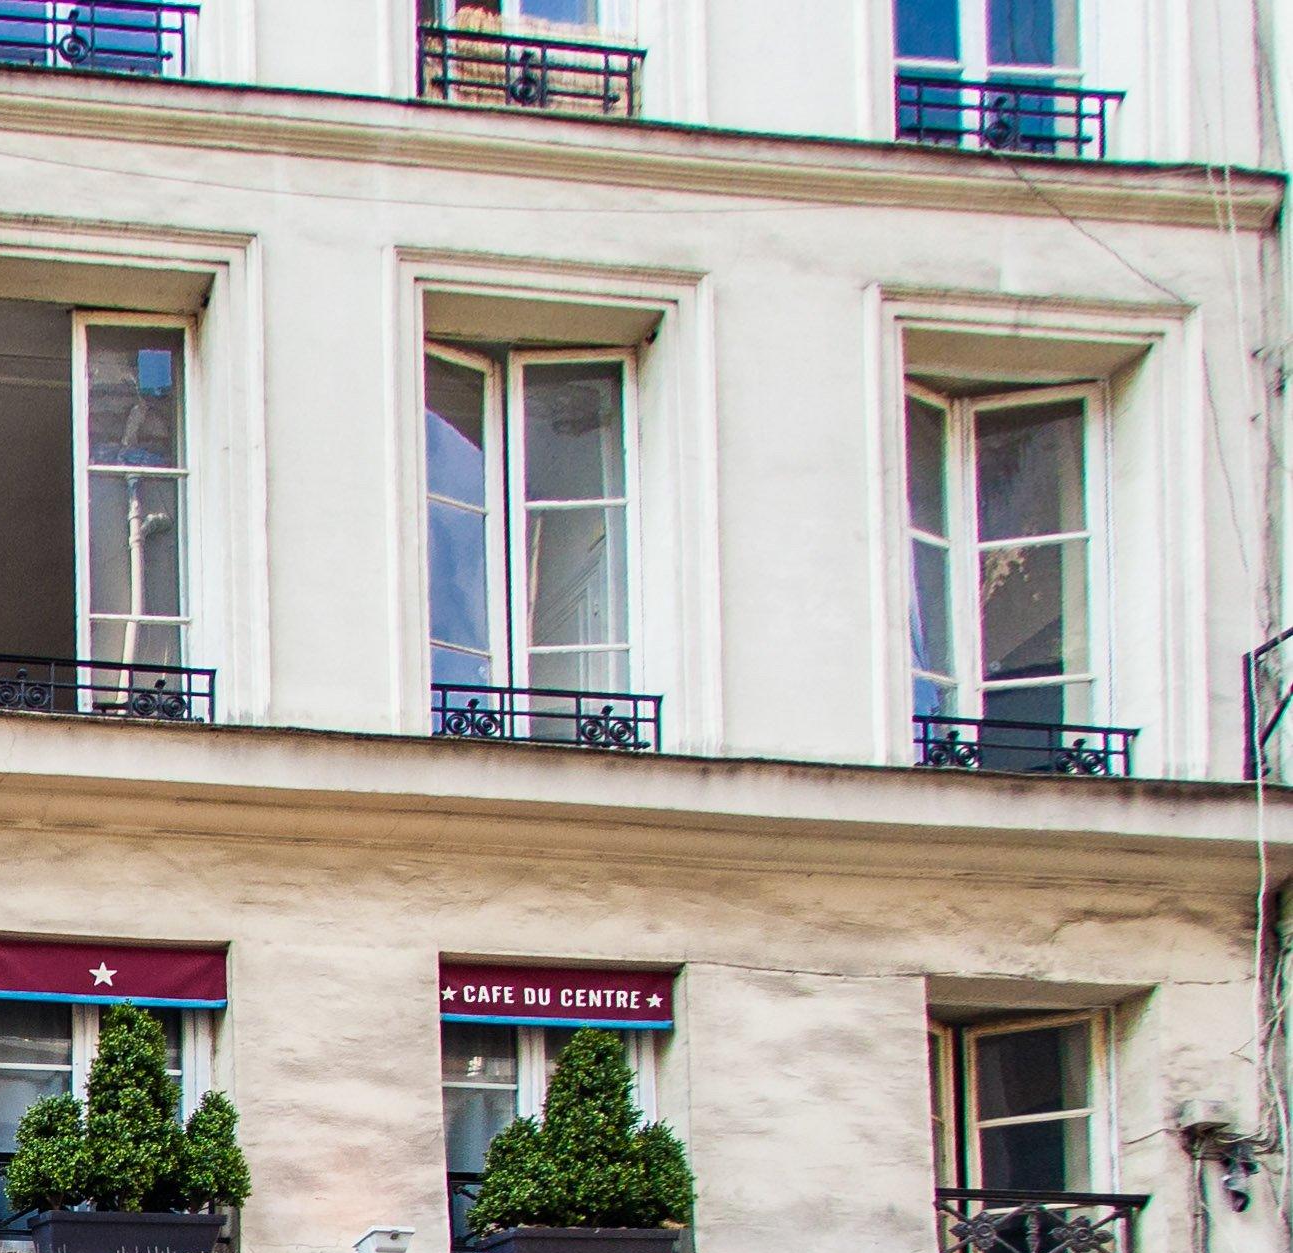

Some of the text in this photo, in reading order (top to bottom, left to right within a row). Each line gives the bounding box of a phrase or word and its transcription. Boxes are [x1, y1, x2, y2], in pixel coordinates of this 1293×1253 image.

[463, 985, 641, 1009] CAFE DU CENTRE
